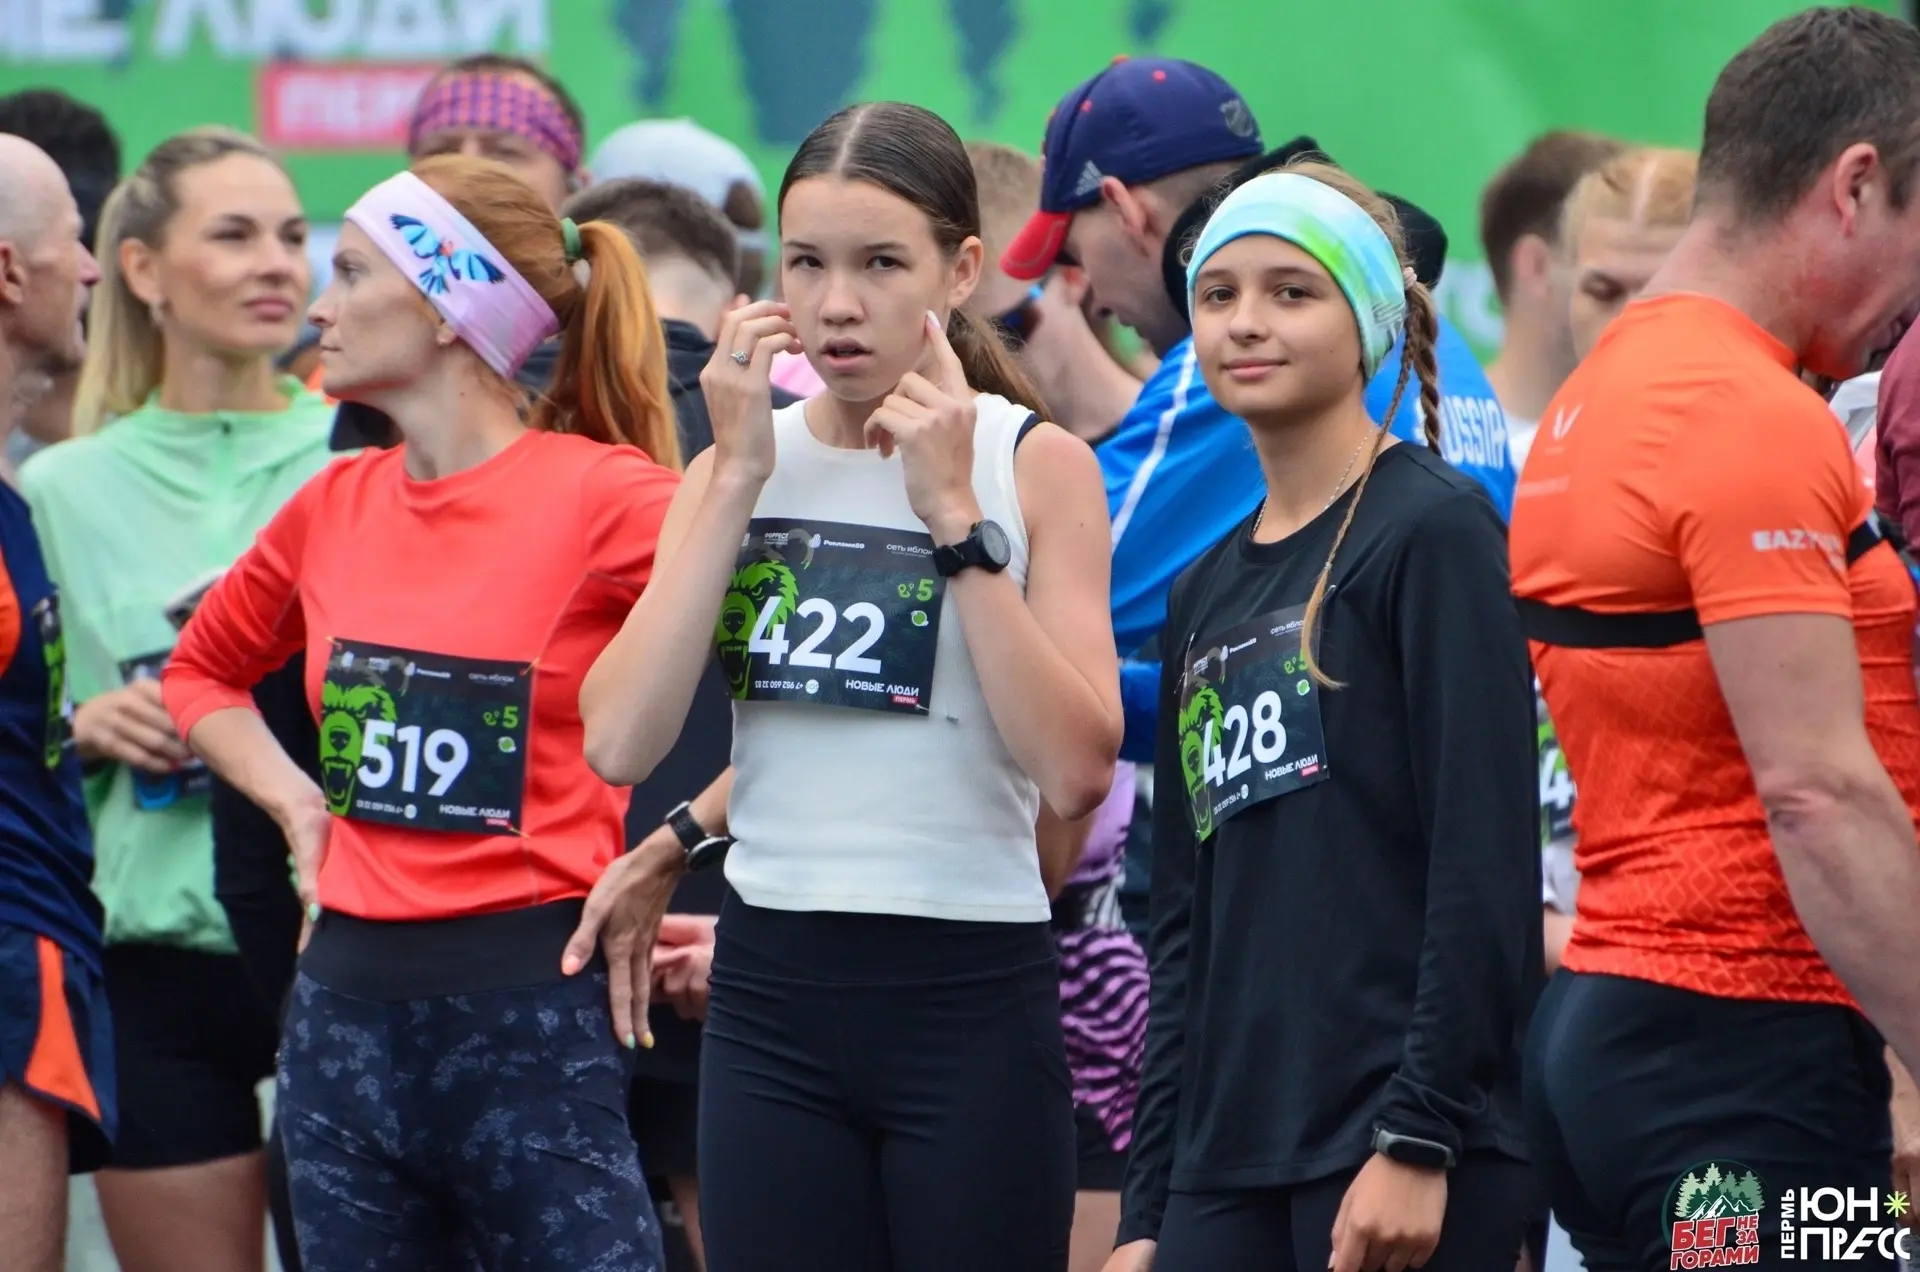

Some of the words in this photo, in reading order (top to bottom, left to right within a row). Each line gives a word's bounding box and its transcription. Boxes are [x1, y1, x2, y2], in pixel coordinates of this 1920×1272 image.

[1412, 394, 1506, 471] USSIA
[916, 578, 934, 601] 5
[748, 596, 885, 674] 422
[1286, 620, 1304, 629] ябло
[845, 679, 885, 692] НОВЫЕ
[886, 684, 919, 696] ЛЮДИ
[503, 706, 519, 728] 5
[1202, 691, 1287, 787] 428
[357, 718, 469, 797] 519
[1265, 763, 1294, 781] НОВЫЕ
[1295, 754, 1319, 770] ЛЮДИ
[439, 804, 477, 816] НОВЫЕ
[478, 808, 511, 818] ЛЮДИ
